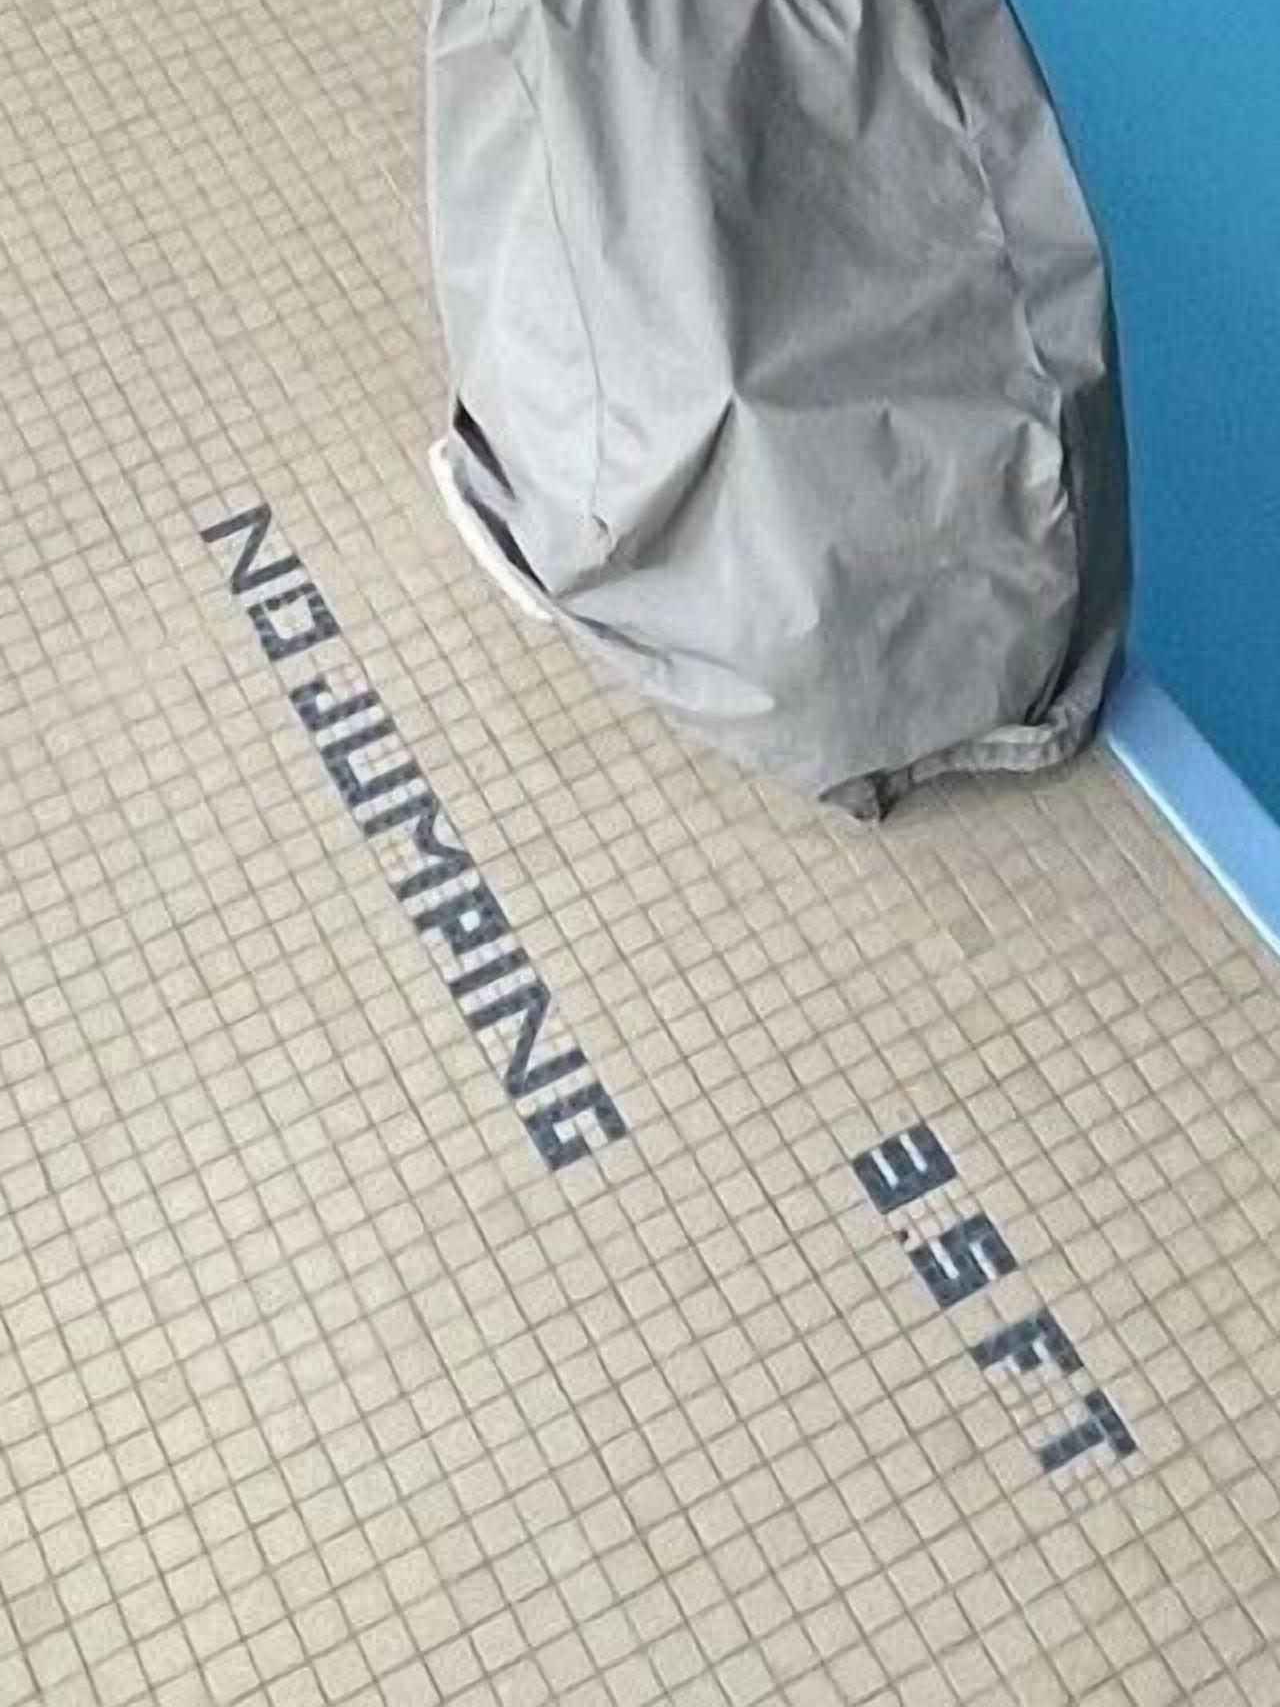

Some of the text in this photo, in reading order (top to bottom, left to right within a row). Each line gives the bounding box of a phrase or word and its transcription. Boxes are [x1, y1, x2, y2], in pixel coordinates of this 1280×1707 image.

[200, 504, 628, 1171] NO JUMPING
[967, 1307, 1138, 1473] FT
